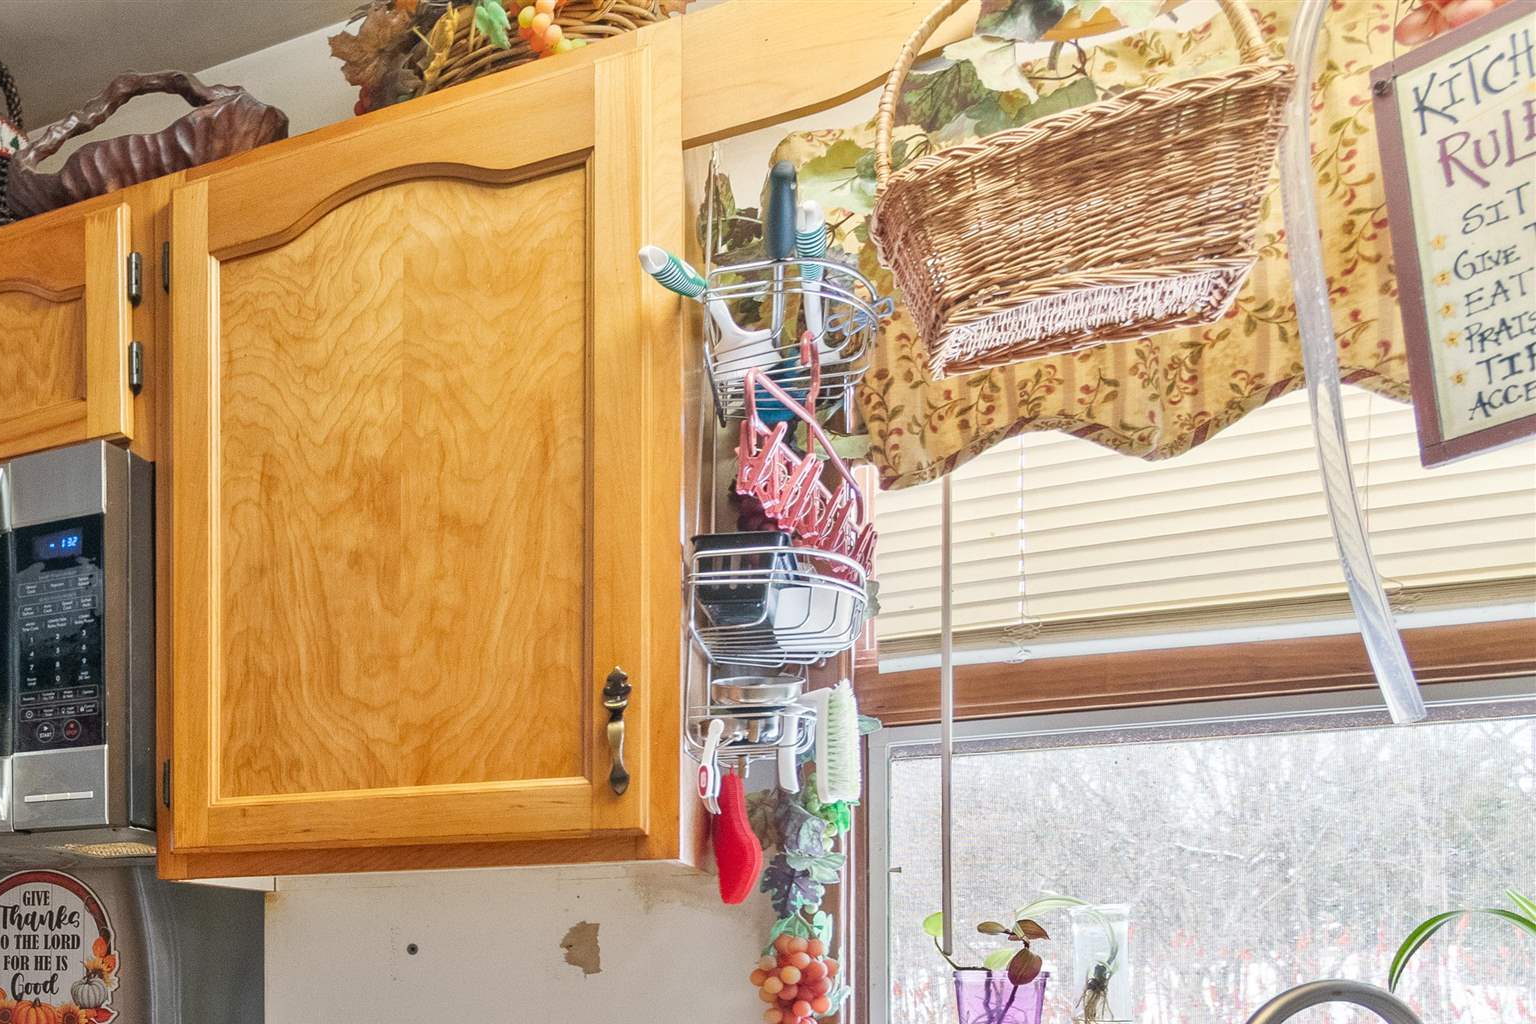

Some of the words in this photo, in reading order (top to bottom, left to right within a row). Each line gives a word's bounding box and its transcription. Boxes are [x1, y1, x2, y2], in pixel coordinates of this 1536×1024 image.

[1412, 29, 1535, 136] KITCH
[1461, 181, 1531, 235] SIT
[1453, 244, 1521, 281] GIVE
[1464, 267, 1535, 317] EAT
[22, 890, 50, 906] GIVE
[14, 934, 40, 950] THE
[44, 934, 80, 950] LORD
[3, 955, 30, 971] FOR
[34, 955, 52, 971] HE
[56, 955, 68, 971] IS
[10, 972, 60, 1001] Good
